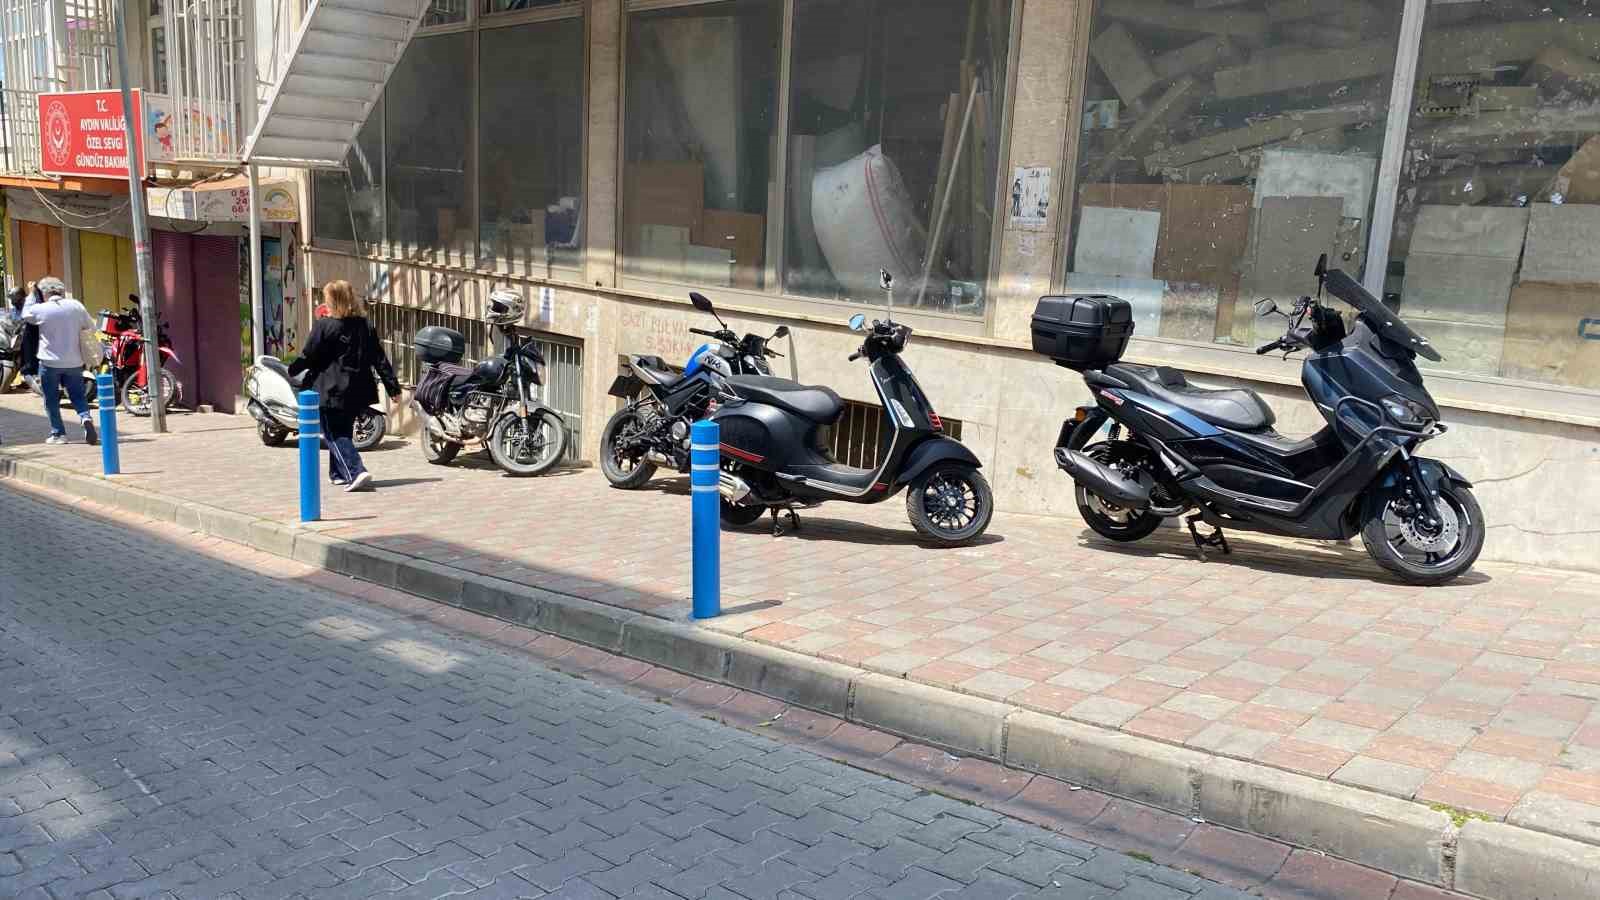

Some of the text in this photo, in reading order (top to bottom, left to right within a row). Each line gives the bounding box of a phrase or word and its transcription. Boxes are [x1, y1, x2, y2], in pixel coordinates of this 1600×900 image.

[80, 115, 127, 131] AYDIN VALİLİĞ
[86, 135, 123, 150] ÖZEL SEVGİ
[75, 153, 104, 168] GÜNDÜZ
